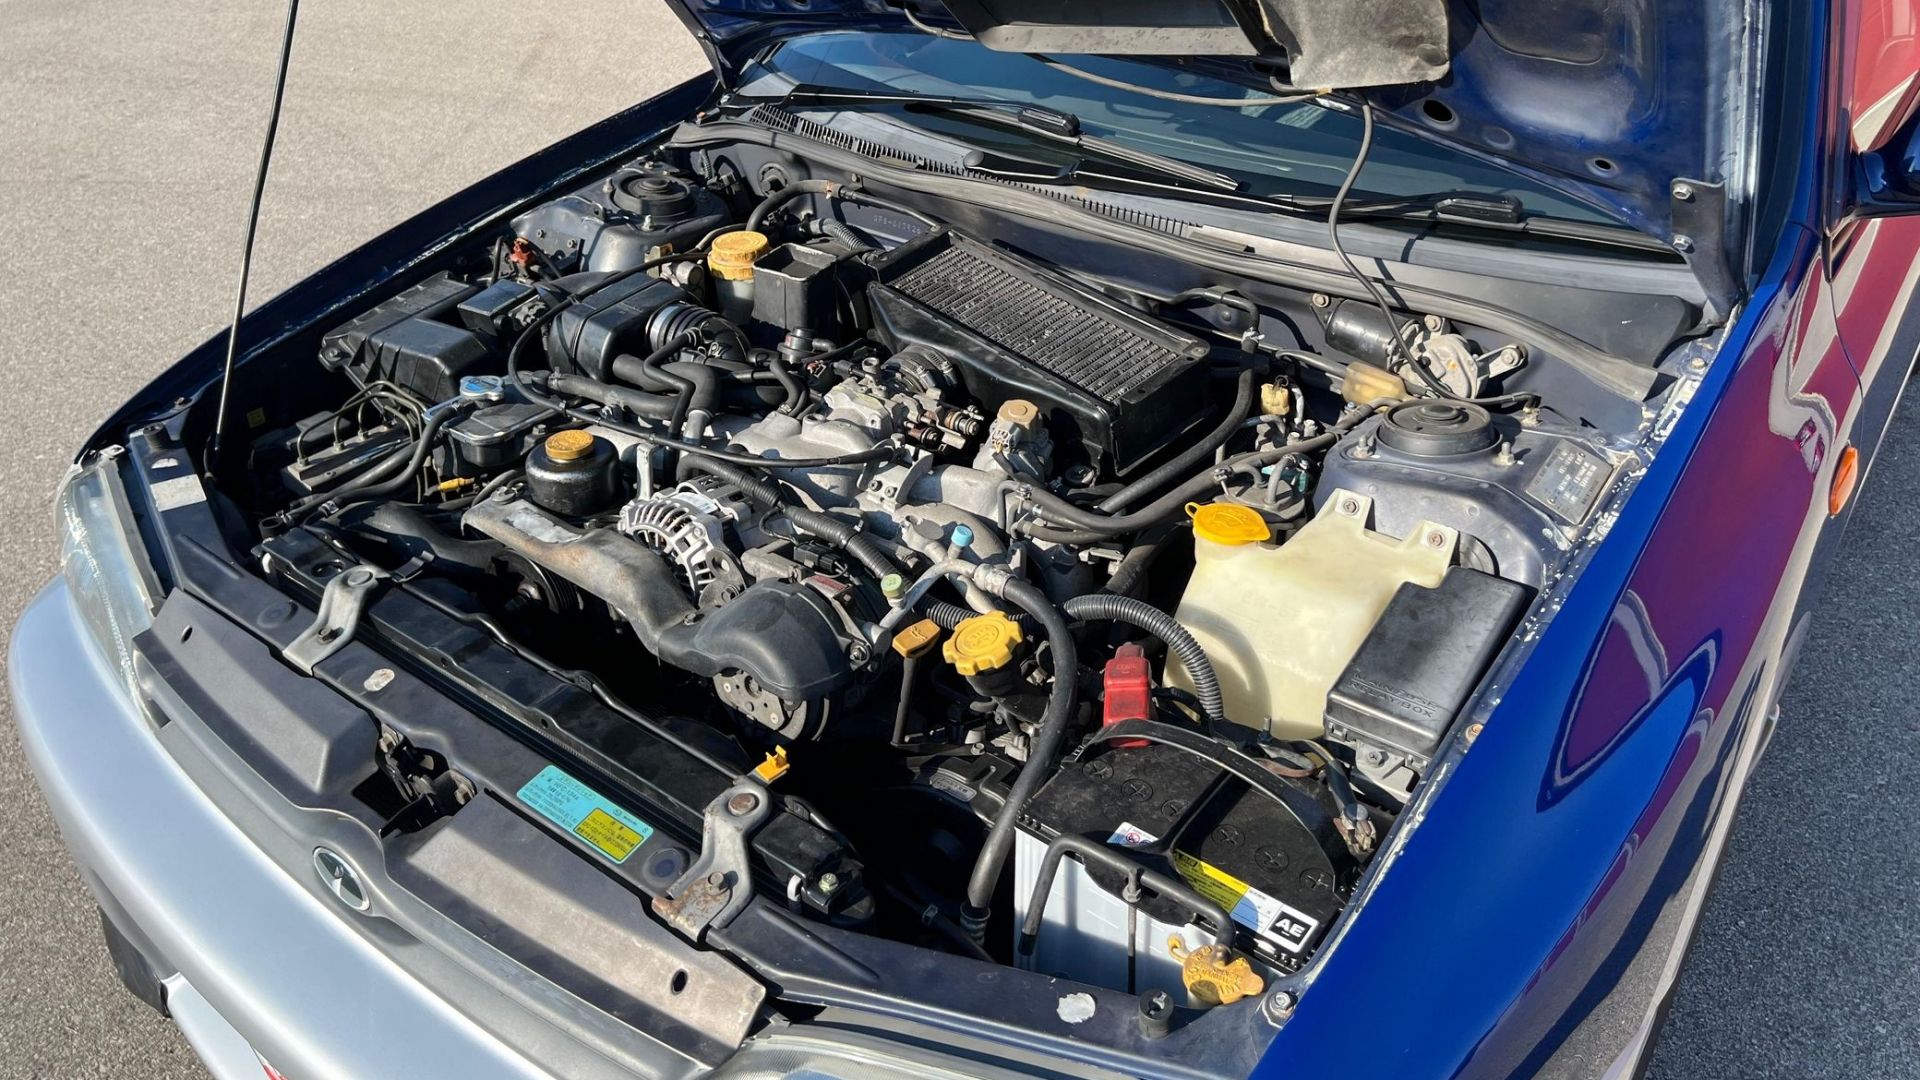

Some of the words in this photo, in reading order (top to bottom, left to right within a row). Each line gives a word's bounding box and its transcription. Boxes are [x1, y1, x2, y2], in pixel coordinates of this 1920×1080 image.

[1353, 671, 1393, 692] MAIN
[1351, 682, 1395, 703] RELAY
[1400, 701, 1433, 718] BOX
[1275, 918, 1306, 938] AE
